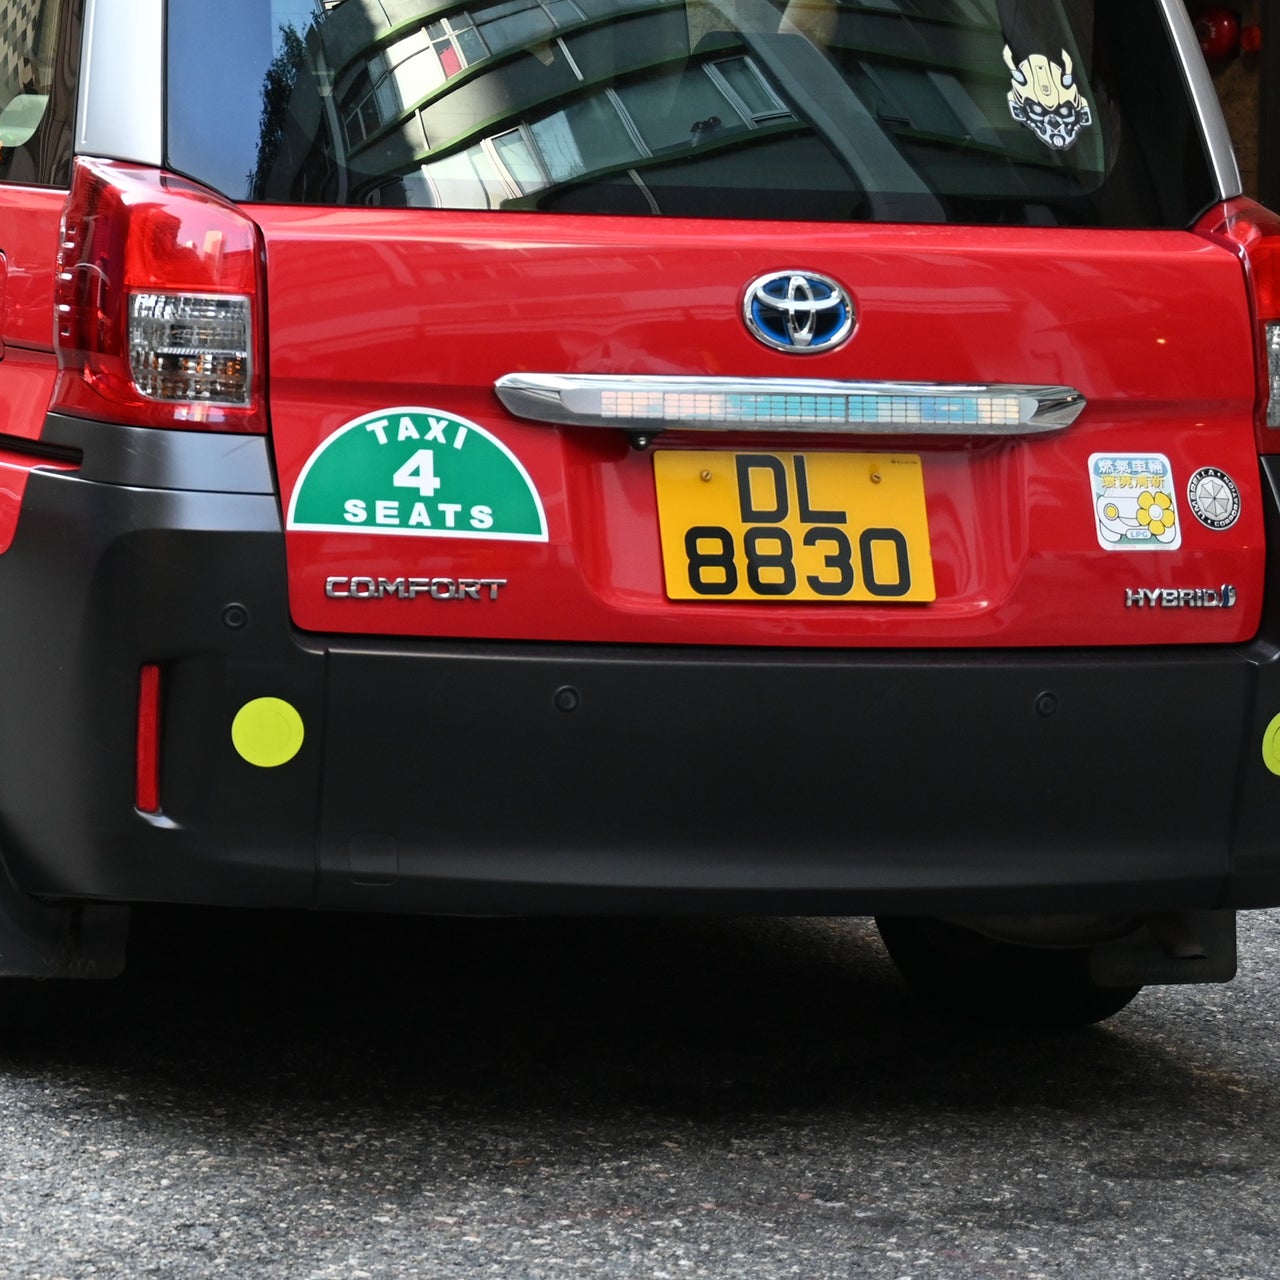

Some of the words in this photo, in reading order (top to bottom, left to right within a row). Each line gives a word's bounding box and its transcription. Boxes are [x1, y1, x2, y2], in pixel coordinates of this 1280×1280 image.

[365, 416, 468, 450] TAXI
[393, 449, 441, 497] 4
[735, 454, 848, 524] DL
[343, 498, 494, 529] SEATS
[1190, 469, 1215, 519] UMBRELLA
[1213, 475, 1240, 528] CORPORATION
[1130, 530, 1149, 538] LPG
[684, 525, 912, 597] 8830
[325, 576, 508, 600] COMFORT
[1125, 587, 1219, 607] HYBRID
